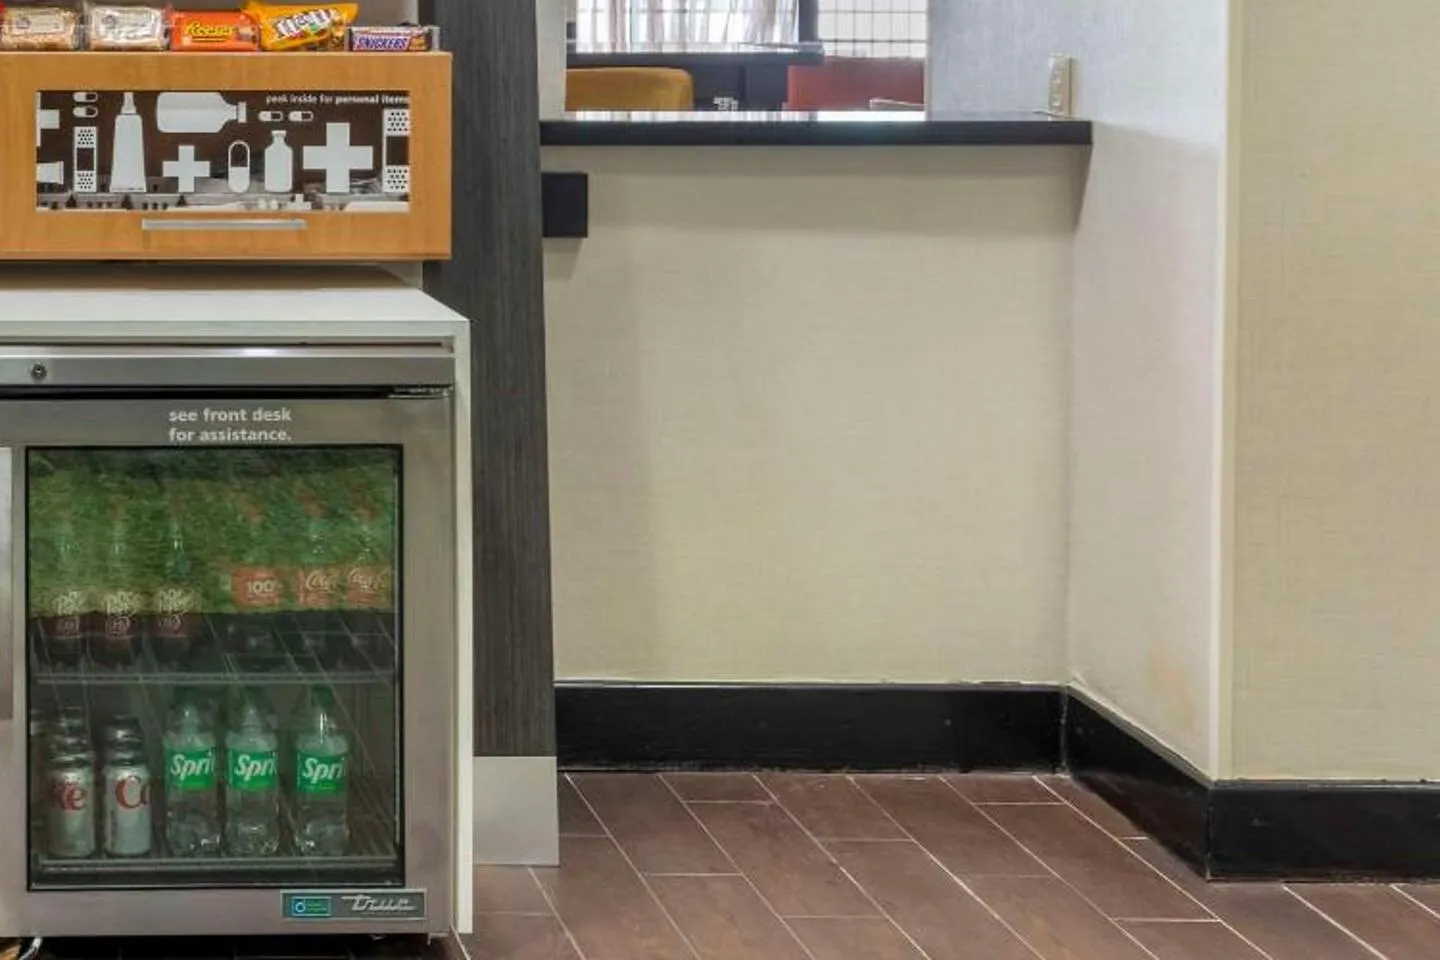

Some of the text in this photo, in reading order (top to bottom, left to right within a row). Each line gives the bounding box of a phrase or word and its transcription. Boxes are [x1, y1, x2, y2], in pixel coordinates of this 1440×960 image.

[358, 37, 408, 50] SNICKERS
[290, 94, 317, 103] inside
[320, 94, 333, 103] for
[335, 94, 379, 105] personal
[169, 406, 292, 421] see front desk
[168, 427, 293, 441] for assistance.
[246, 580, 275, 595] 100
[170, 751, 215, 781] Spri
[234, 751, 278, 781] Spri
[301, 756, 346, 785] Spri
